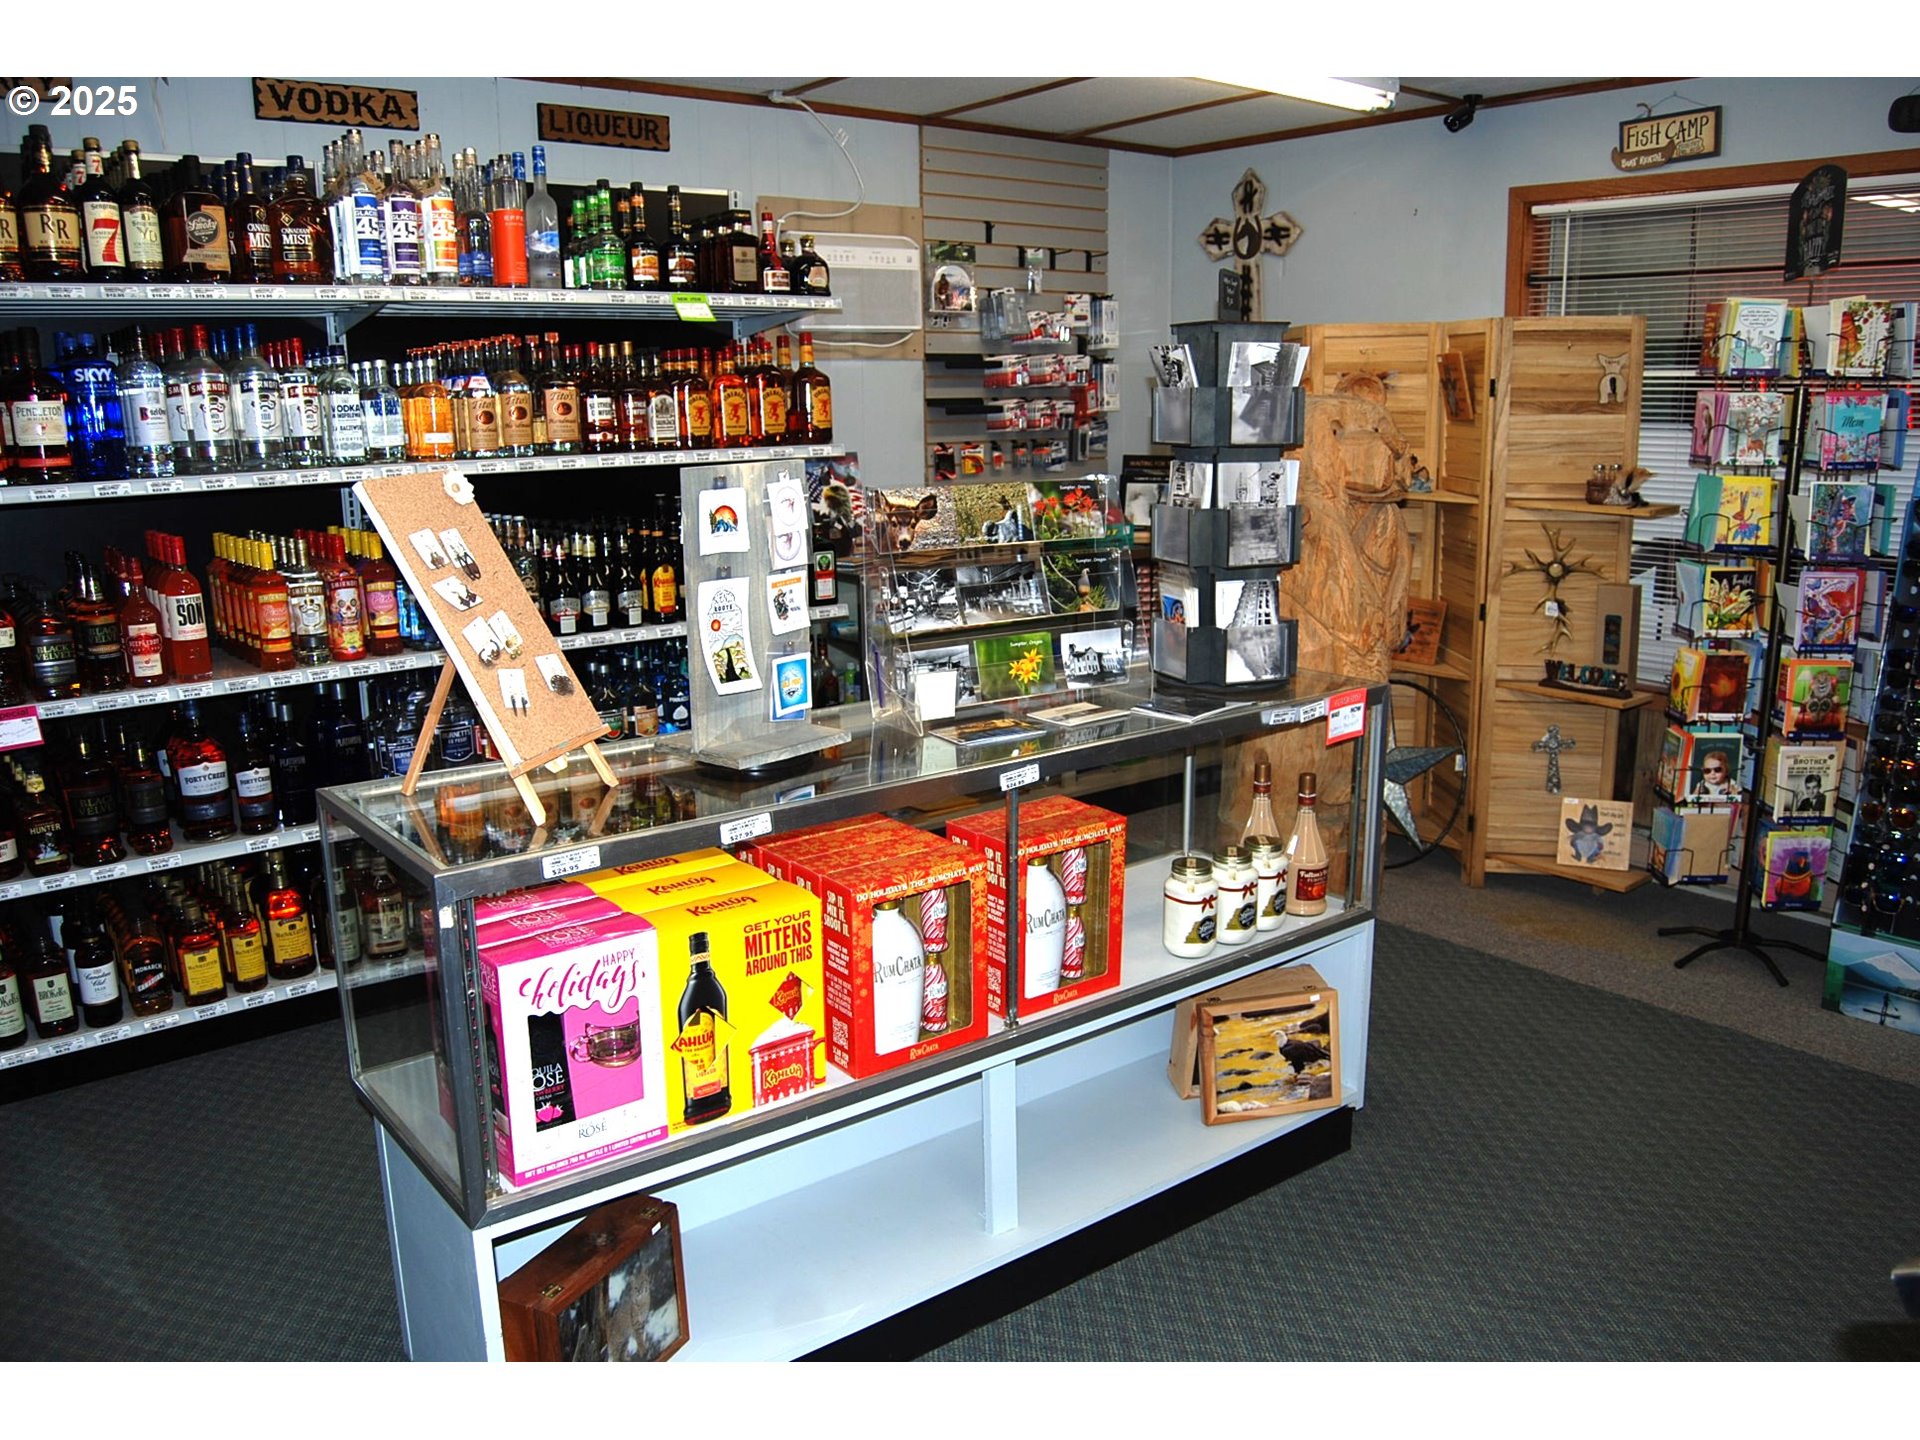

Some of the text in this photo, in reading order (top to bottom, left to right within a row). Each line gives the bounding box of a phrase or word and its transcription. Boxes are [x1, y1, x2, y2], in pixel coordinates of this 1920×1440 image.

[265, 85, 406, 121] VODKA
[549, 109, 661, 144] LIQUEUR
[1627, 125, 1660, 150] FISH
[1665, 114, 1710, 141] CAMP
[91, 217, 121, 263] 7
[249, 233, 272, 248] MIS
[282, 234, 312, 246] MIST
[74, 367, 112, 383] SKYY
[176, 602, 204, 626] SON
[1544, 658, 1628, 692] WELCOME
[29, 822, 62, 836] HUNTER
[730, 830, 754, 842] $27.95
[551, 864, 580, 876] $24.95
[869, 882, 908, 900] HOLIDAYS
[910, 879, 926, 889] THE
[968, 864, 984, 874] WAY
[827, 890, 836, 905] SIP
[826, 902, 837, 918] MIX
[743, 910, 811, 934] GET YOUR
[824, 913, 842, 933] SHOOT
[744, 920, 812, 960] MITTENS
[602, 948, 636, 968] HAPPY
[746, 944, 813, 977] AROUND THIS
[134, 962, 163, 975] MONARCH
[532, 1062, 564, 1077] QUILA
[532, 1070, 565, 1092] OSE
